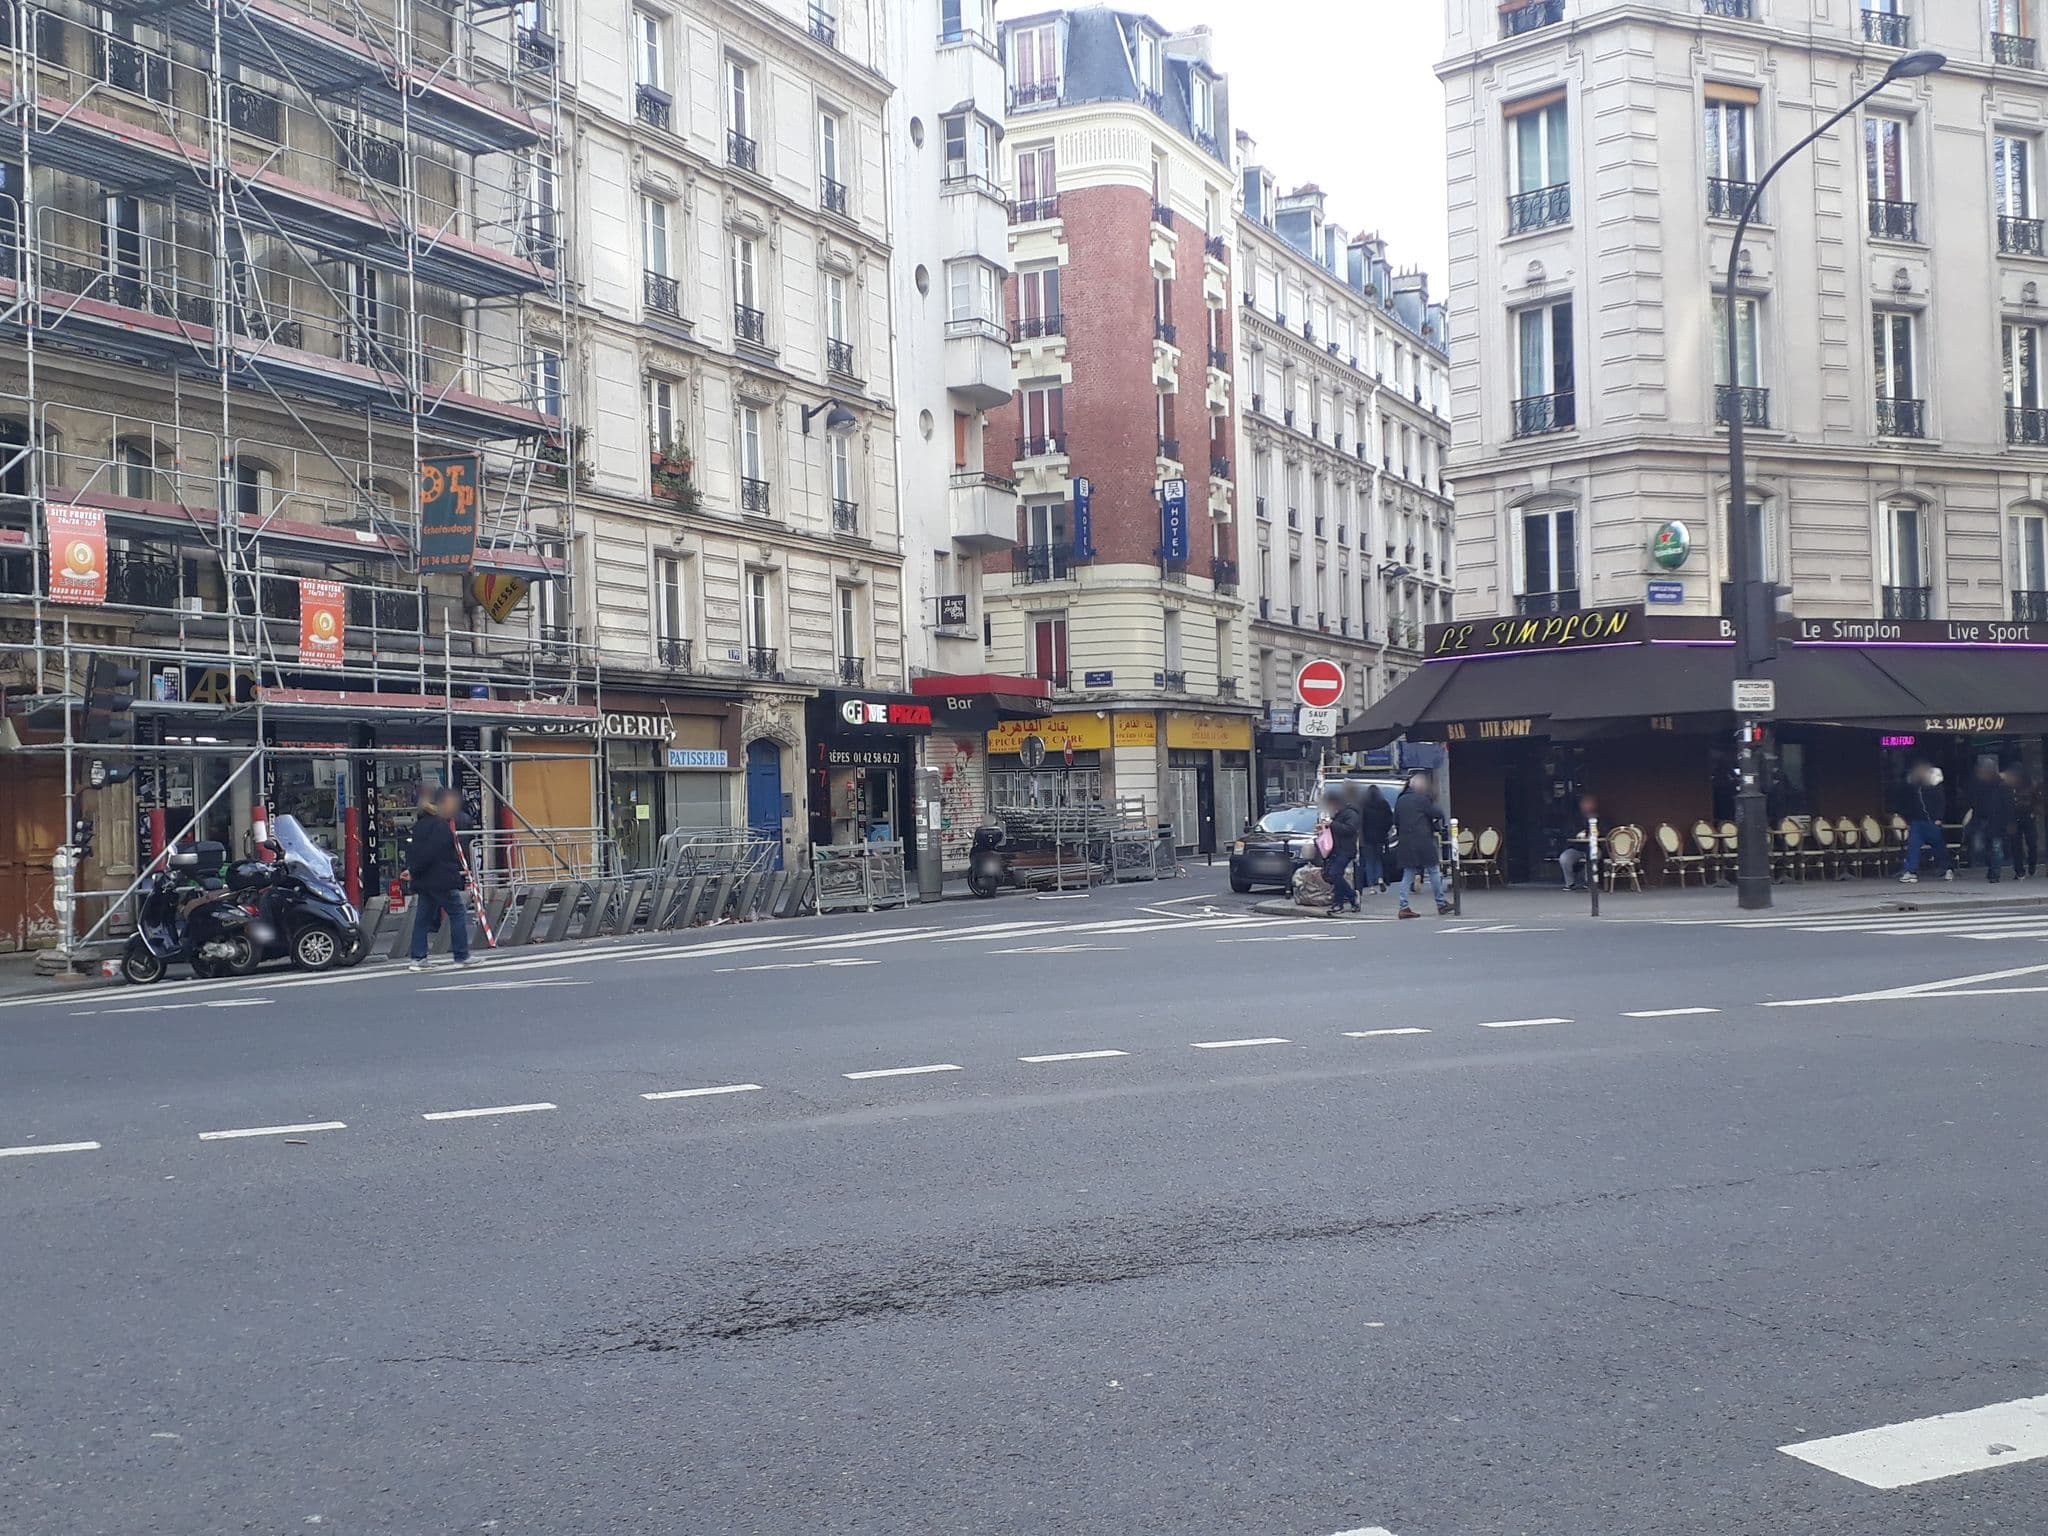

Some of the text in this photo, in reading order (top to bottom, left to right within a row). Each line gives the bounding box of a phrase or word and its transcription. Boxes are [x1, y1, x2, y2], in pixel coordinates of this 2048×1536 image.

[51, 508, 67, 517] SITE
[1170, 507, 1179, 557] HOTEL
[491, 581, 519, 617] PRESSE
[1434, 611, 1629, 654] LE SIMPLON
[1801, 620, 1901, 642] Le Simplon
[1948, 623, 2030, 644] Live Sport
[946, 696, 973, 710] Bar
[1308, 710, 1328, 718] SAUF
[1447, 719, 1532, 740] BAR LIVE SPORT
[1945, 717, 2005, 732] SIMPLON
[669, 752, 726, 766] PATISSERIE
[853, 753, 862, 764] 01
[863, 753, 872, 764] 42
[873, 753, 882, 764] 58
[883, 753, 891, 764] 62
[891, 753, 900, 764] 21
